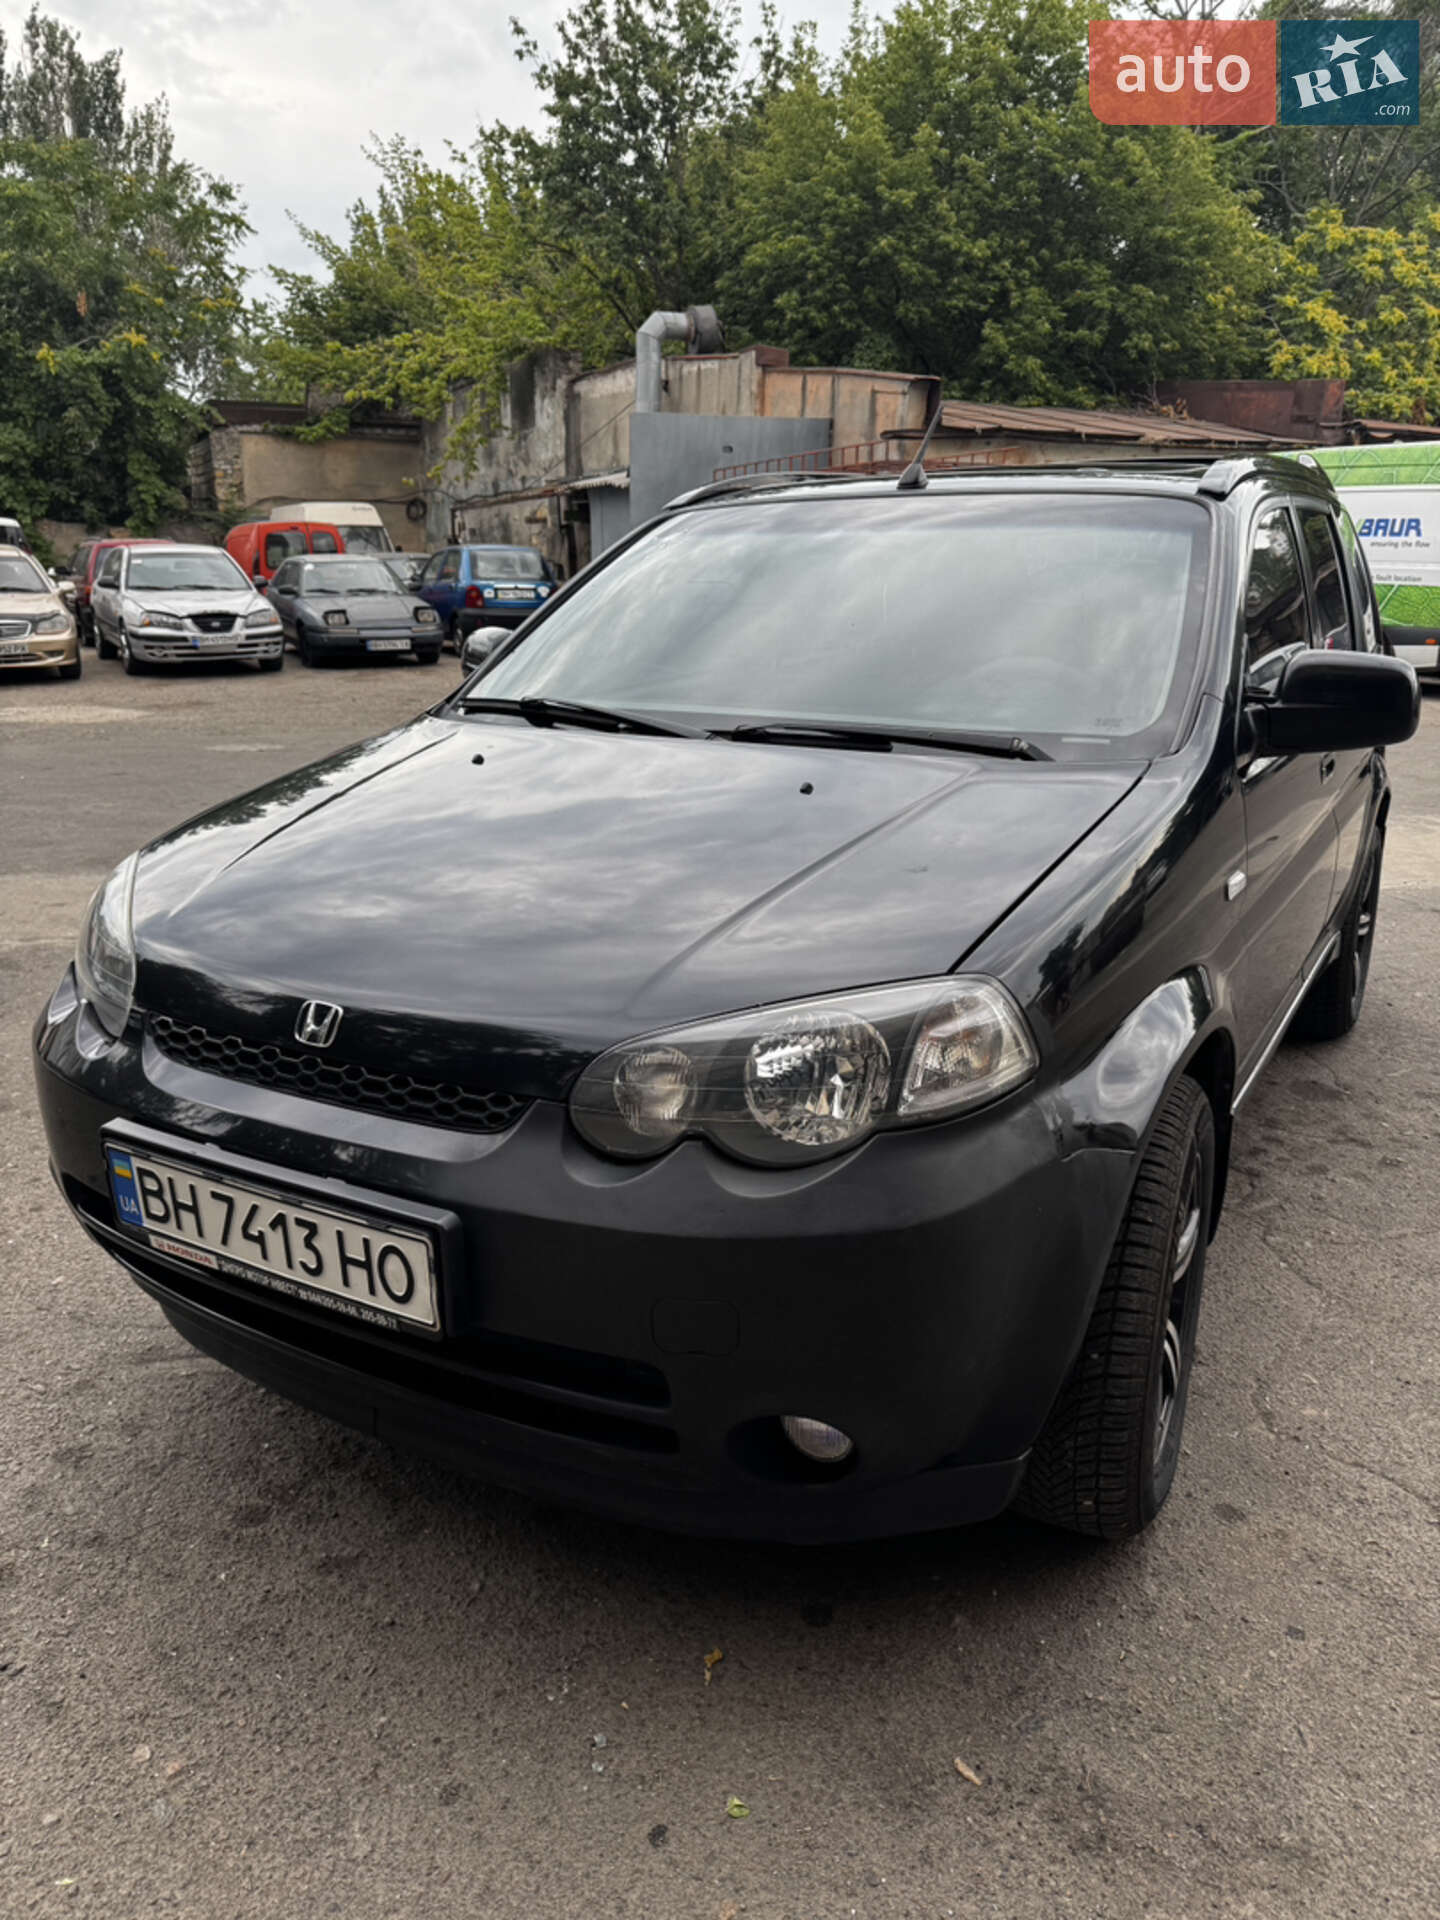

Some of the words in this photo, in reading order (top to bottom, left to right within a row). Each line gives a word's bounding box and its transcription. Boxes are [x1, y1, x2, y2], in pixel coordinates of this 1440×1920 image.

[1358, 518, 1422, 538] BAUR
[1370, 540, 1399, 549] ensuring
[1401, 540, 1413, 548] the
[1415, 540, 1431, 548] flow
[1375, 574, 1392, 582] fault
[1393, 574, 1423, 583] location
[120, 1195, 140, 1216] UA
[136, 1166, 205, 1239] BH
[210, 1189, 324, 1278] 7413
[336, 1229, 415, 1305] HO
